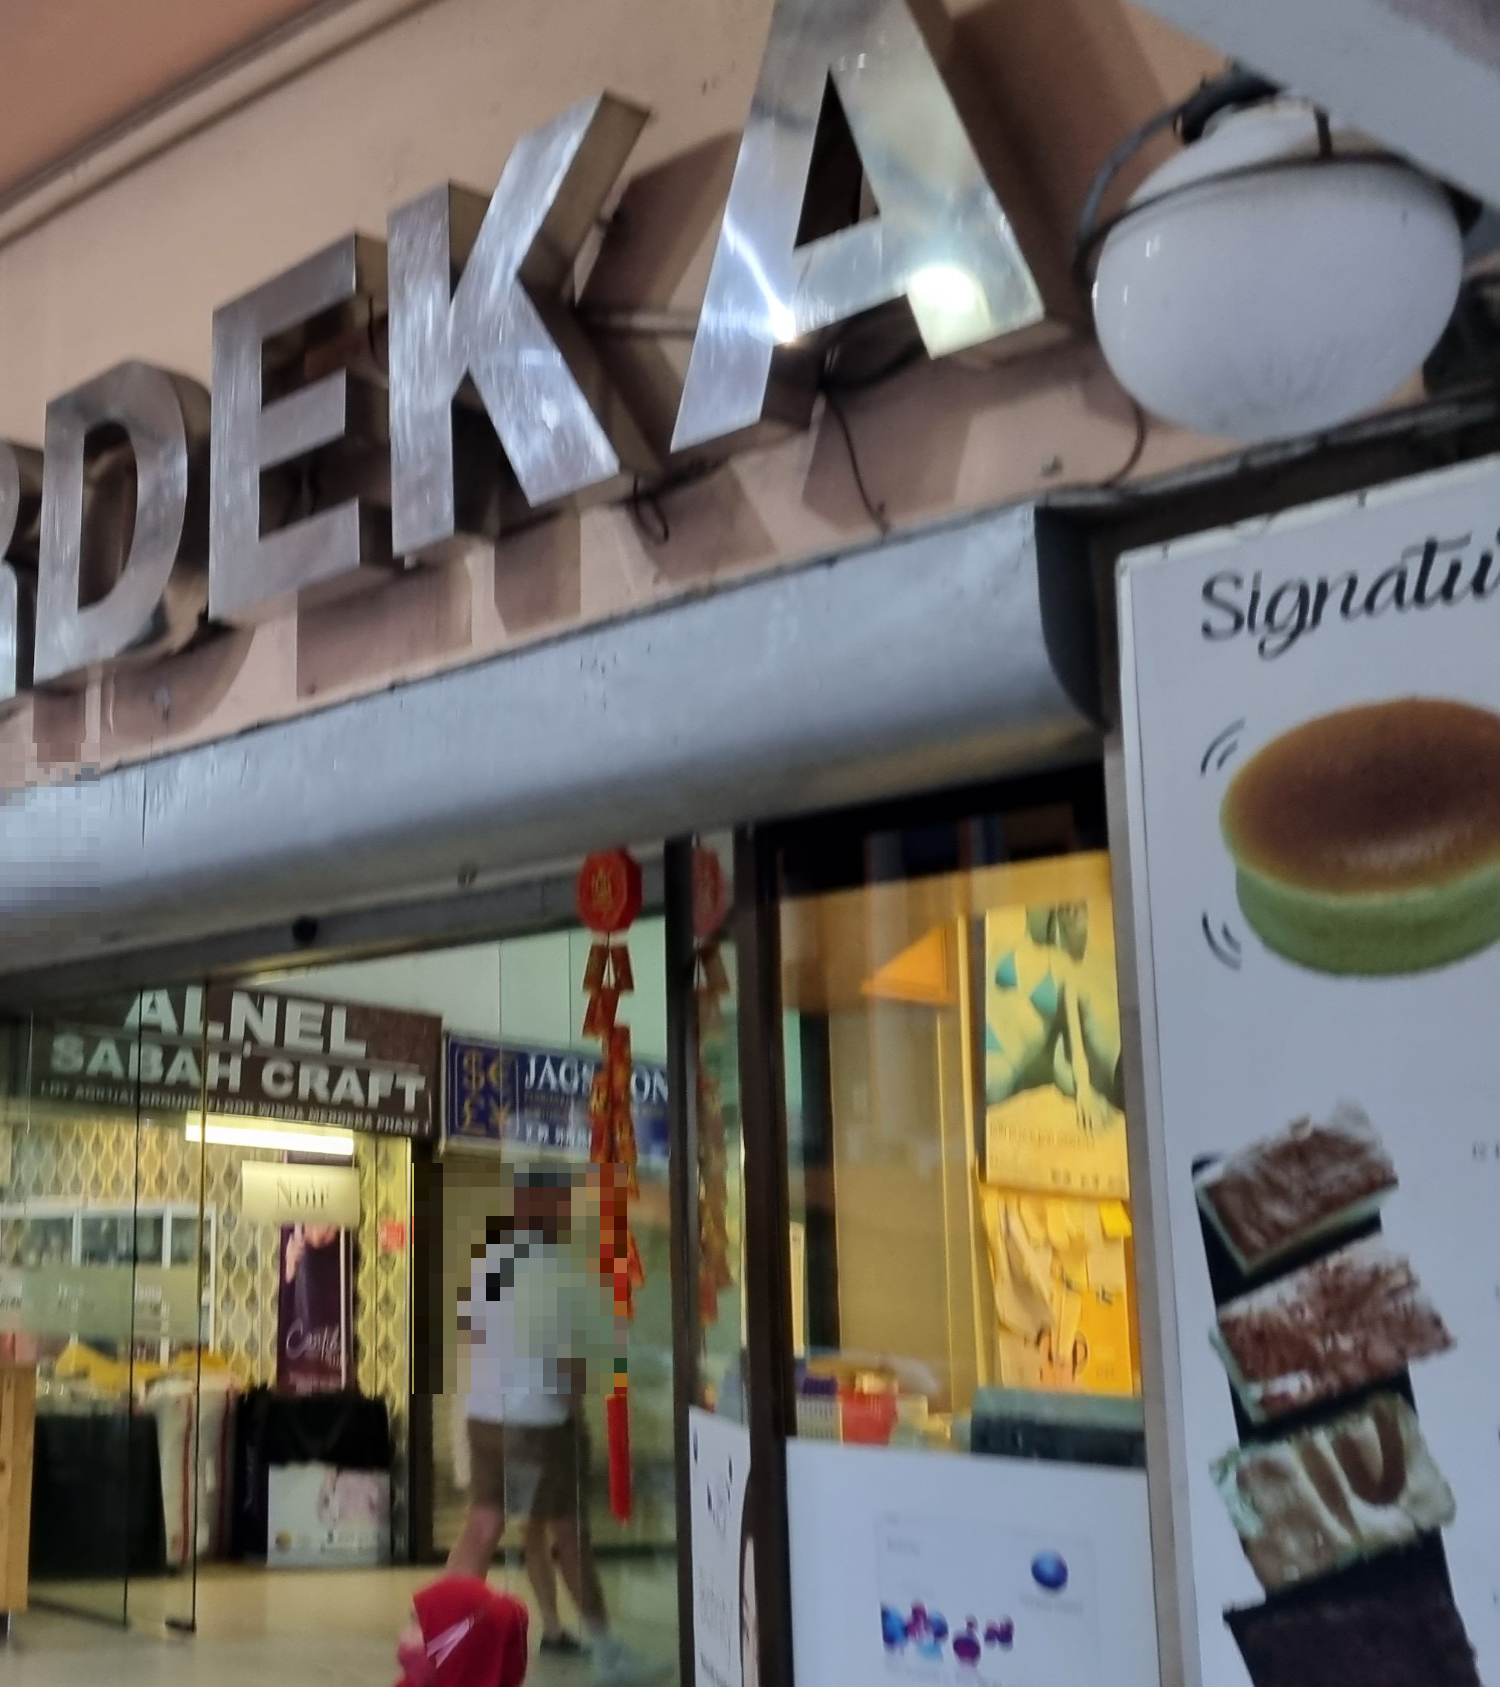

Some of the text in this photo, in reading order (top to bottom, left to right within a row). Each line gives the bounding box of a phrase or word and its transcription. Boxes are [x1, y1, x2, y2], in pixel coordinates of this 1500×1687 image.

[1200, 525, 1500, 661] Signatu
[50, 1032, 426, 1114] SABAH CRAFT
